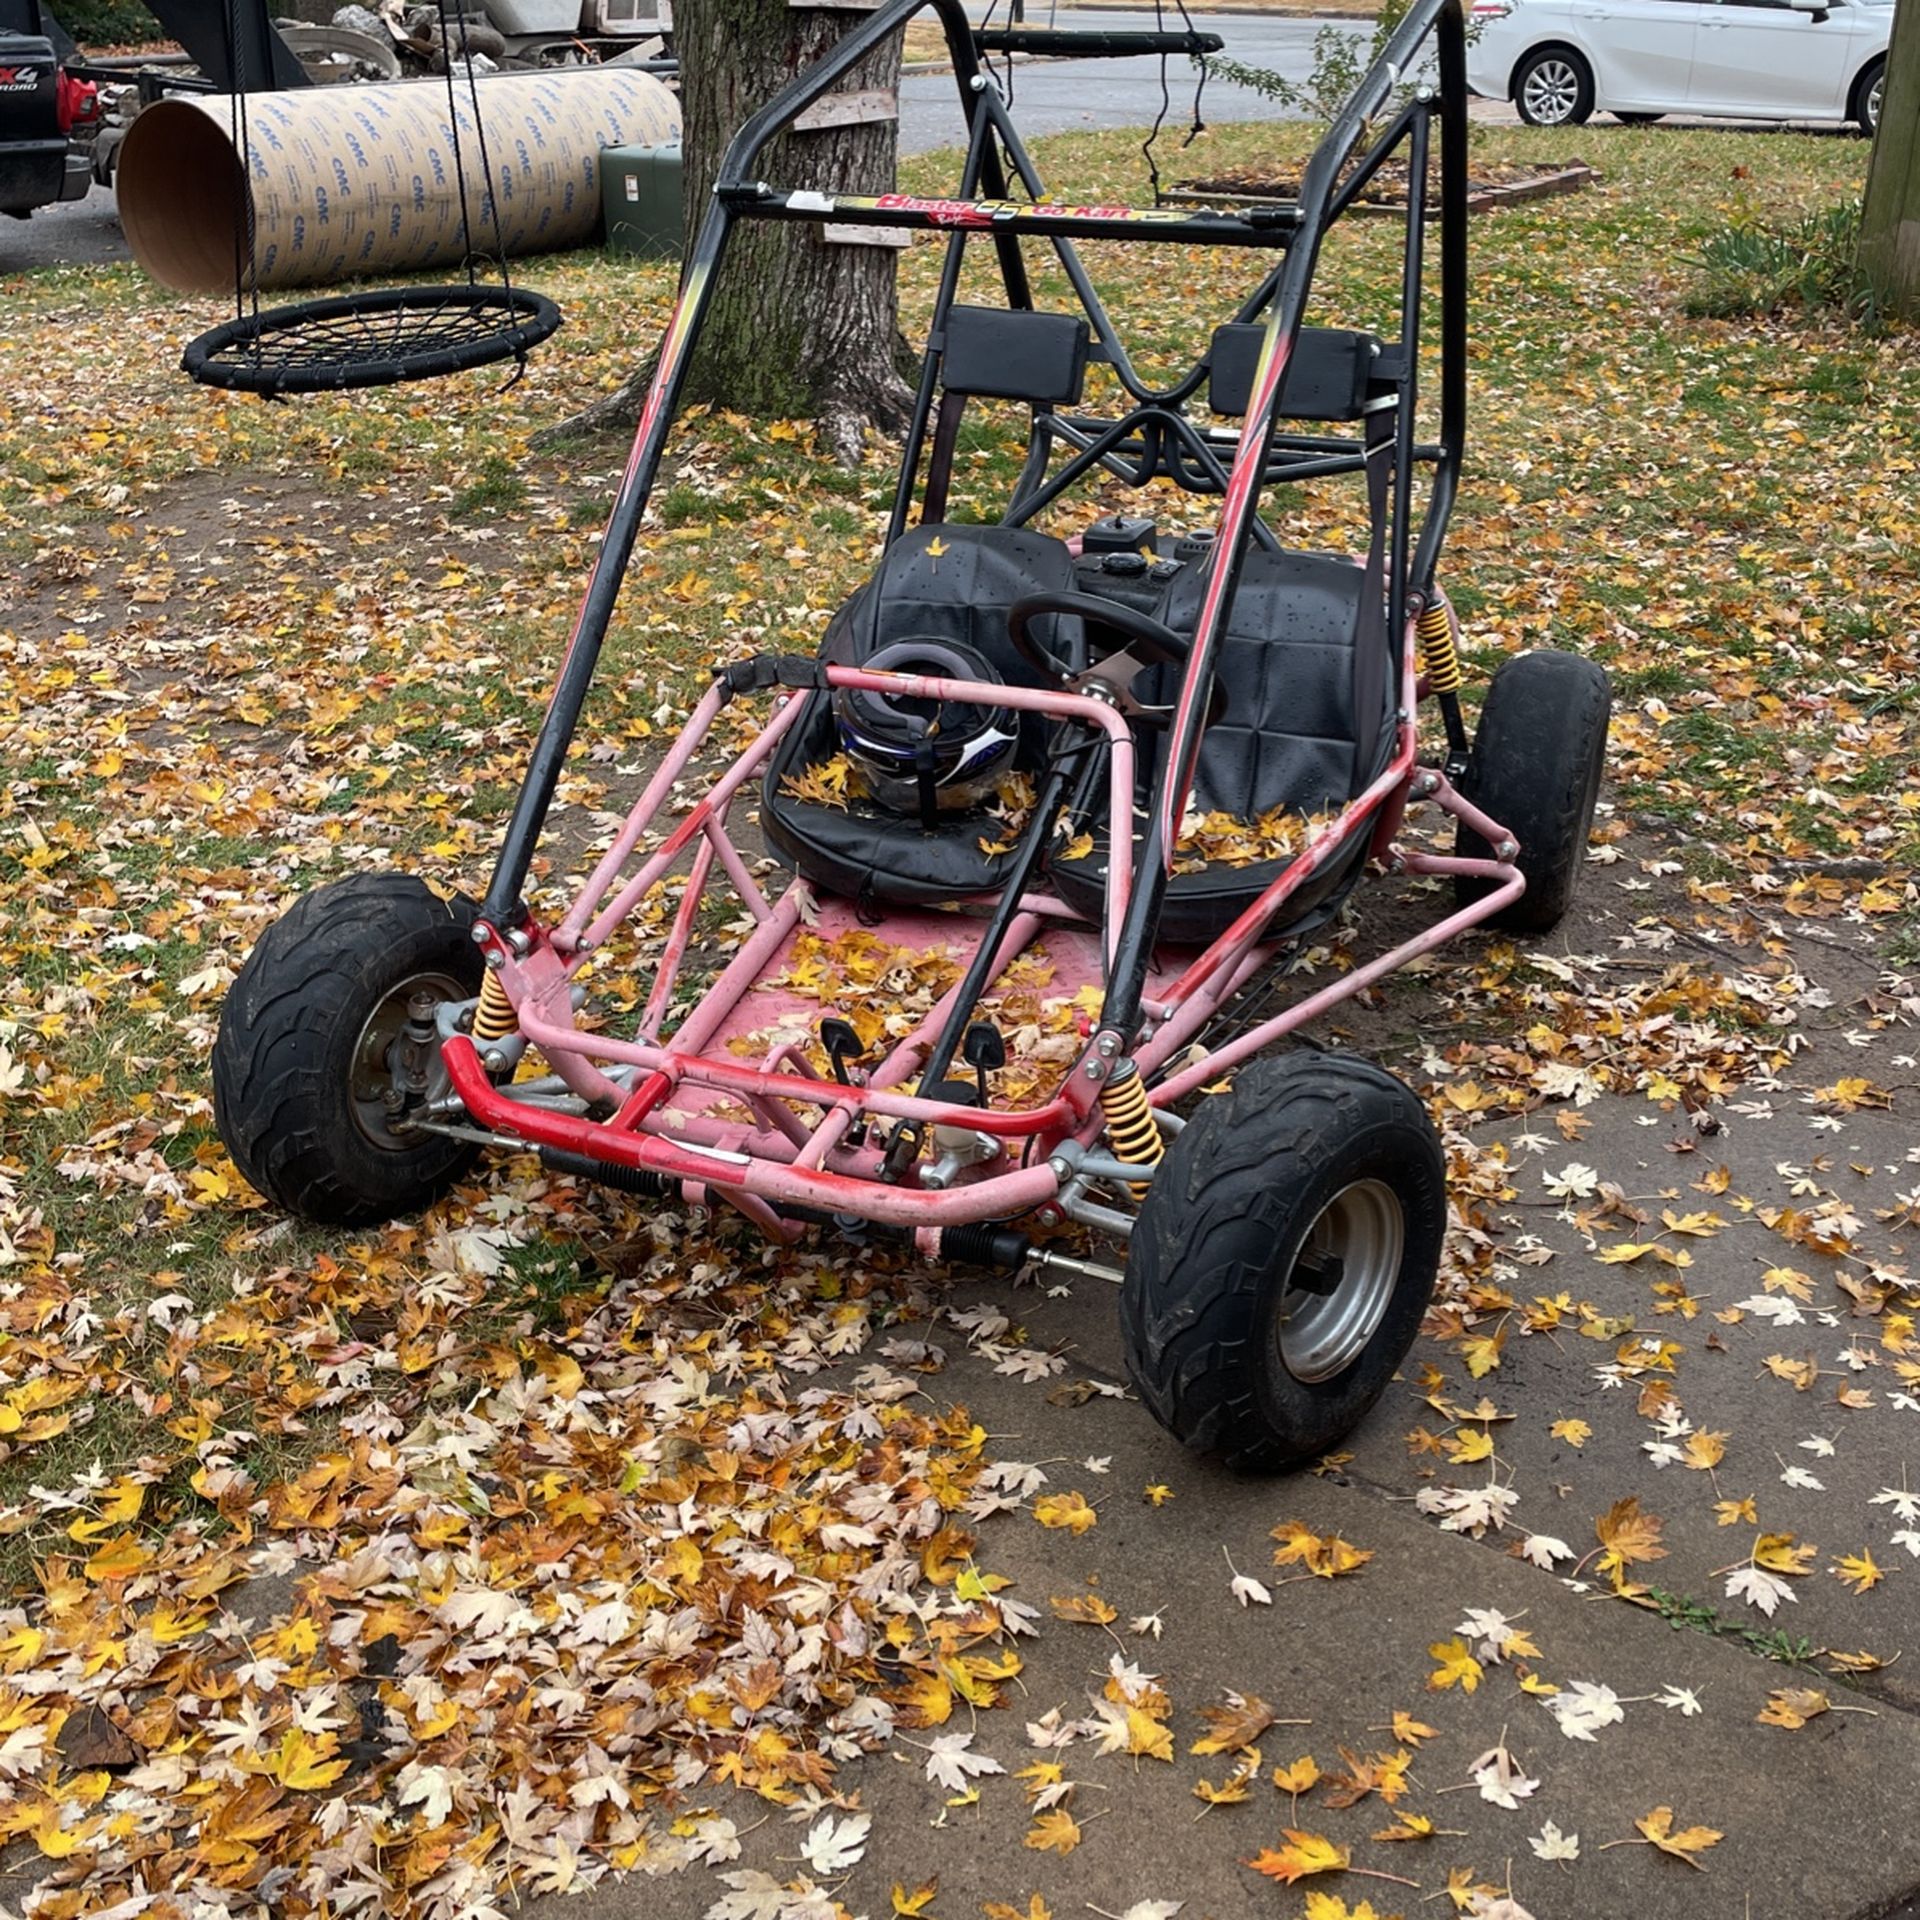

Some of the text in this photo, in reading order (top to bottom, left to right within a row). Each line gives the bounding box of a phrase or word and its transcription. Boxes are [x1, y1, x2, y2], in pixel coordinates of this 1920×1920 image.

[531, 96, 557, 125] CMC
[609, 91, 633, 117] CMC
[254, 117, 283, 151] CMC
[354, 111, 382, 142] CMC
[525, 115, 547, 150] CMC
[604, 109, 625, 141] CMC
[247, 141, 269, 178] CMC
[345, 132, 369, 168] CMC
[428, 148, 446, 186] CMC
[516, 139, 532, 177] CMC
[332, 157, 351, 197] CMC
[502, 164, 513, 201] CMC
[583, 155, 594, 191] CMC
[316, 186, 330, 225] CMC
[413, 175, 425, 213] CMC
[875, 193, 975, 213] Blaster
[1032, 205, 1066, 216] Go
[1073, 206, 1133, 219] Kart
[293, 215, 305, 251] CMC
[389, 203, 402, 239] CMC
